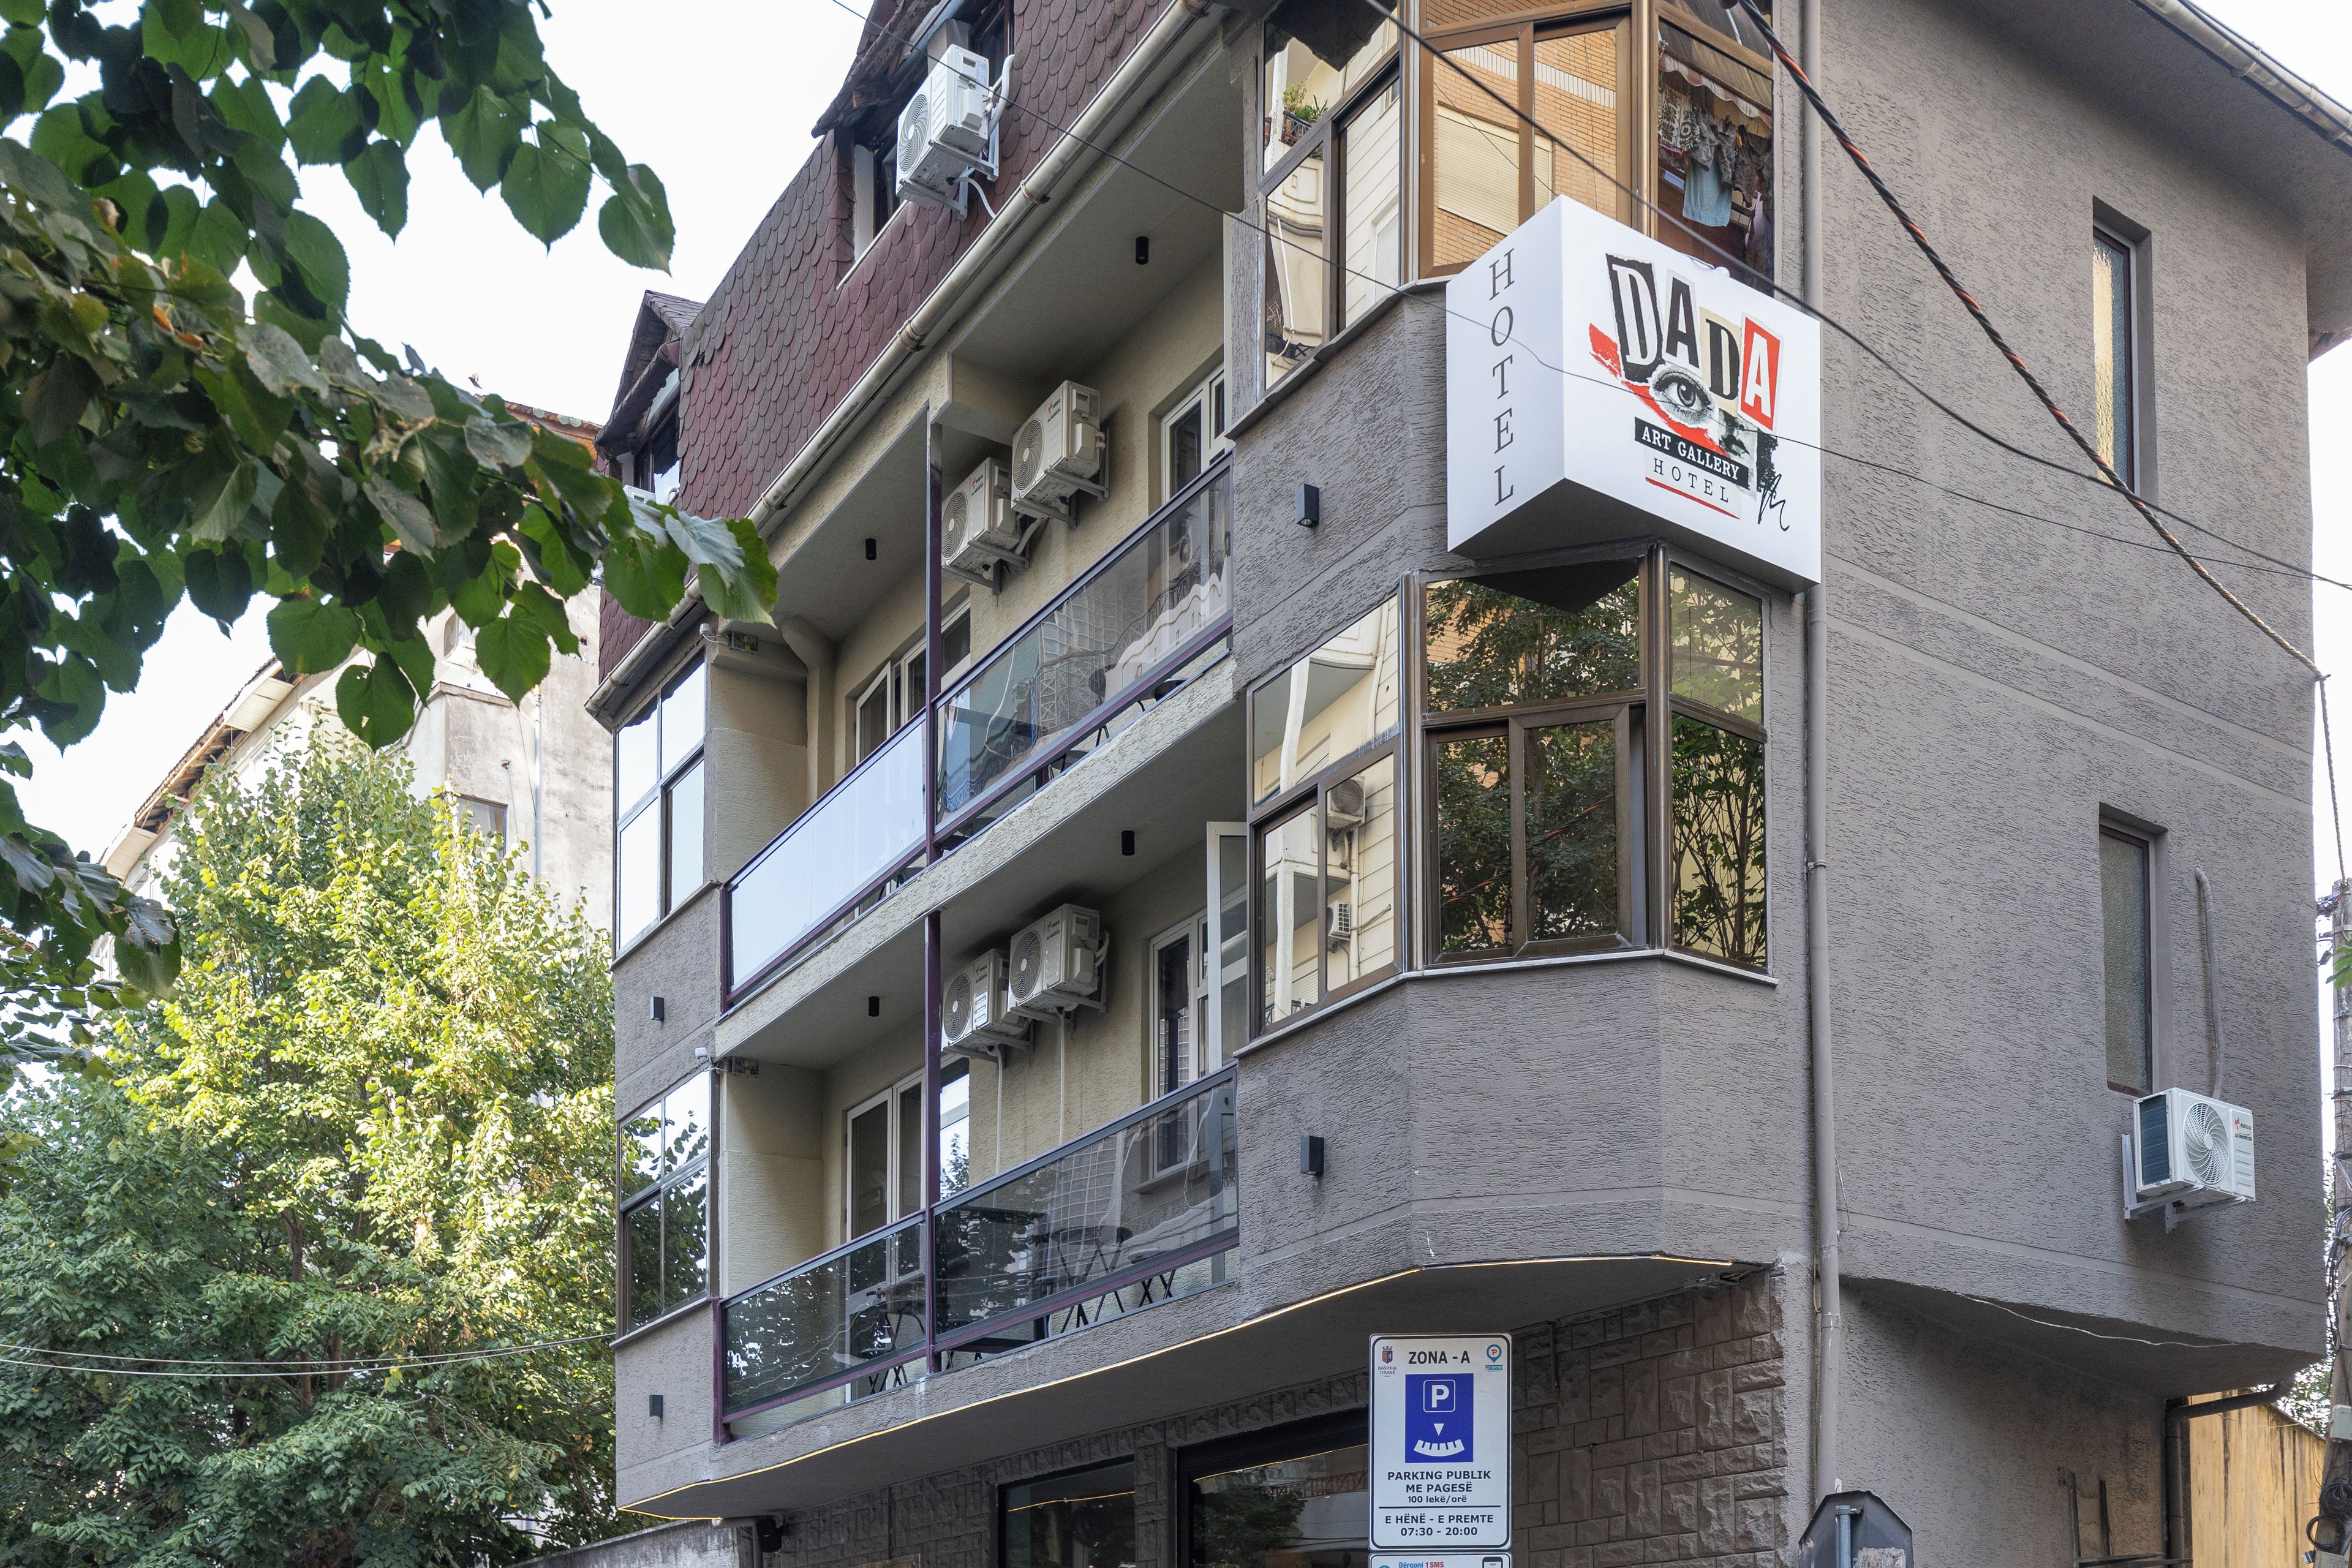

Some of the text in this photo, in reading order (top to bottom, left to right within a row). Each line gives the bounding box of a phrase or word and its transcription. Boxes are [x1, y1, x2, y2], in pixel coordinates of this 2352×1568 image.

[1611, 264, 1772, 418] DADA
[1489, 247, 1515, 507] HOTEL
[1642, 426, 1740, 480] ART GALLERY
[1654, 458, 1728, 503] HOTEL
[1409, 1351, 1447, 1364] ZONA
[1460, 1351, 1470, 1363] A
[1431, 1385, 1449, 1408] P
[1387, 1471, 1491, 1480] PARKING PUBLIK
[1406, 1482, 1472, 1493] ME PAGESË
[1426, 1495, 1467, 1504] lekë/orë
[1385, 1515, 1392, 1524] E
[1395, 1513, 1426, 1524] HËNË
[1438, 1515, 1444, 1523] E
[1448, 1514, 1493, 1523] PREMTE
[1400, 1528, 1433, 1536] 07:30
[1445, 1527, 1478, 1536] 20:00
